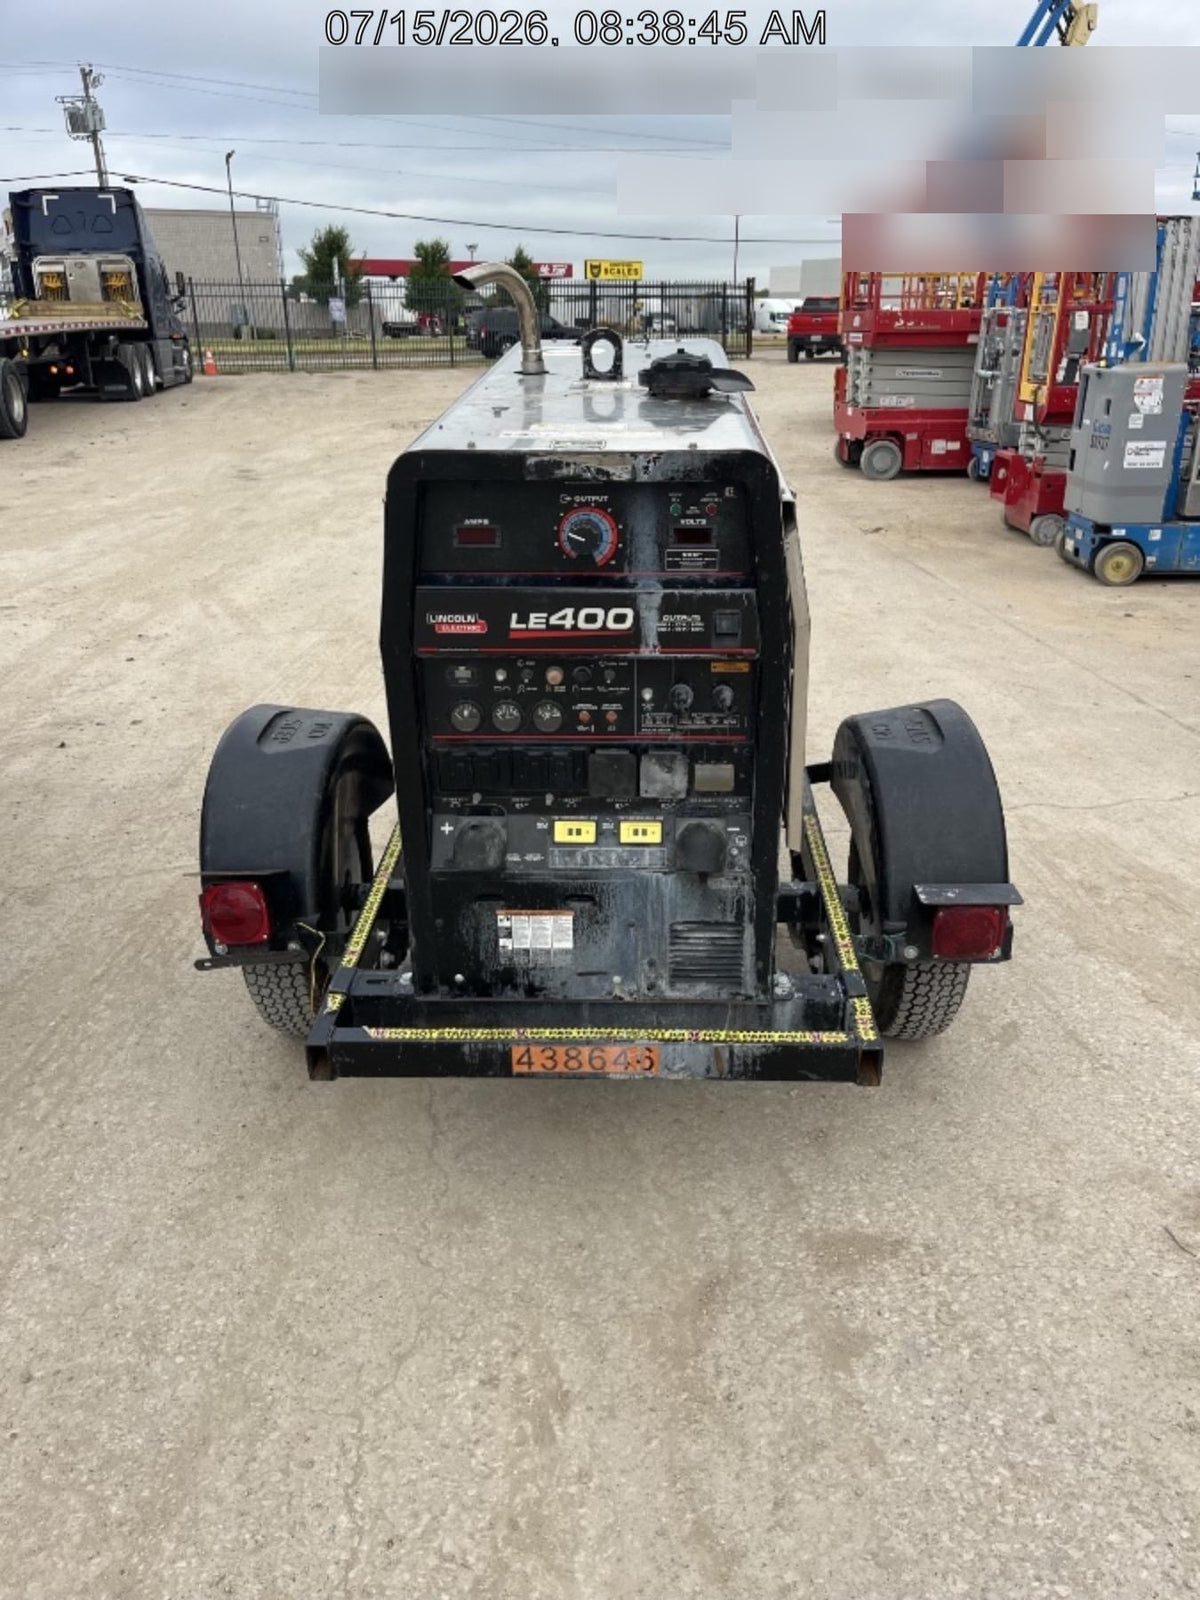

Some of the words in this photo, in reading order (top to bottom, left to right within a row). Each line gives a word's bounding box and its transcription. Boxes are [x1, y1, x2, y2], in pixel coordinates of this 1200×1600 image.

[604, 267, 639, 276] SCALES
[430, 614, 476, 623] LINCOLN
[509, 607, 635, 630] LE400
